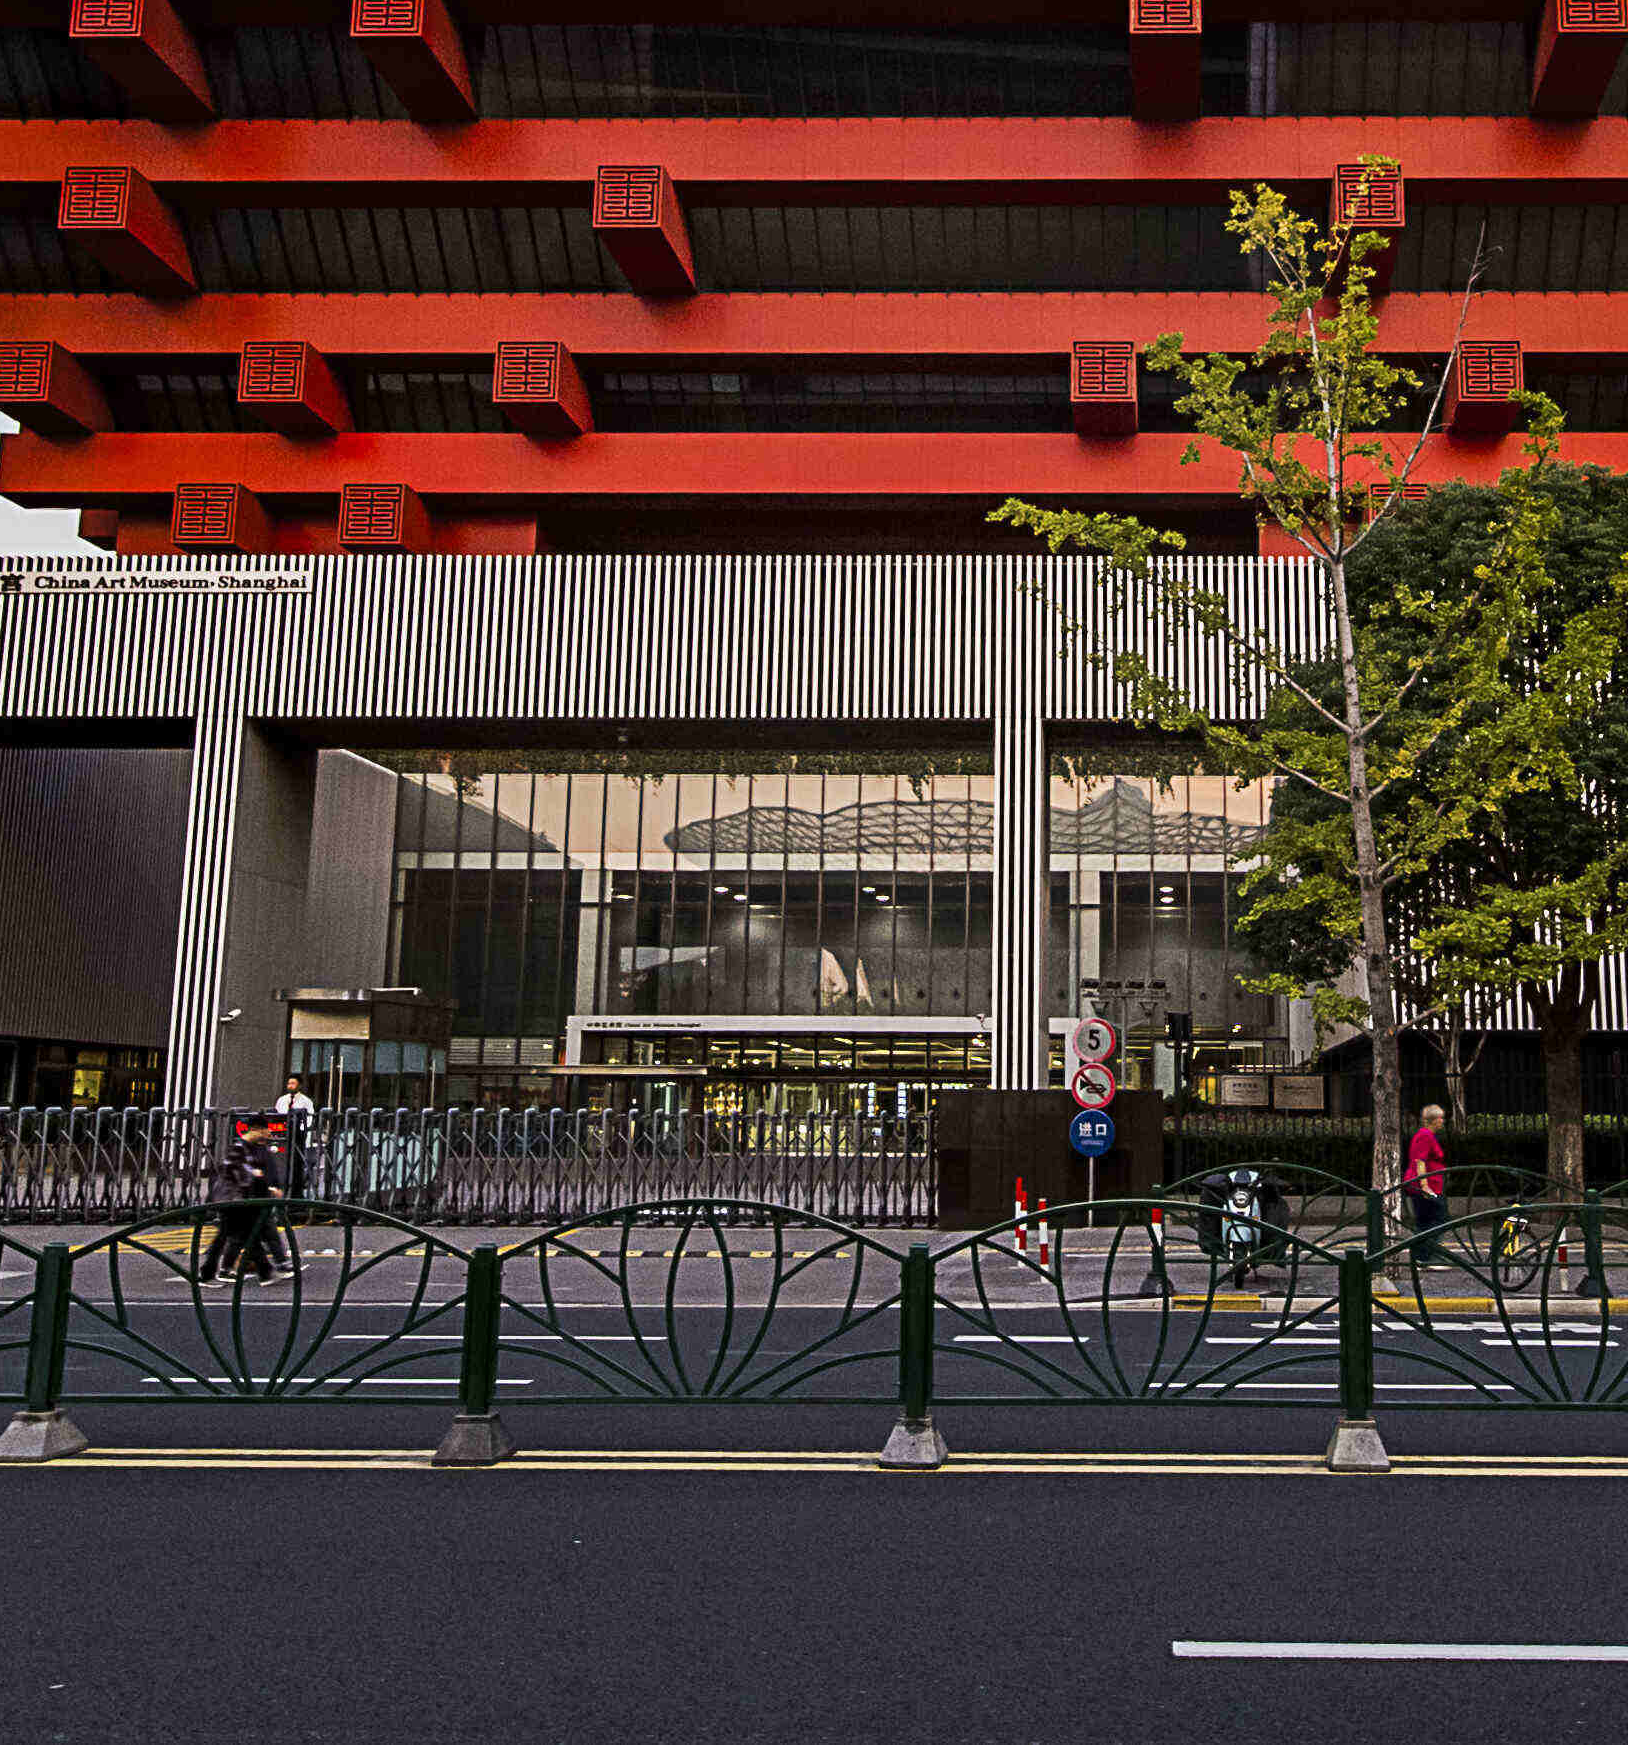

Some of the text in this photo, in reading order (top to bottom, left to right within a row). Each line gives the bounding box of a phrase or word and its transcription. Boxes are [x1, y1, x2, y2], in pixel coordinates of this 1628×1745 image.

[34, 575, 90, 590] China
[94, 576, 126, 589] Art
[217, 575, 307, 591] Shanghai
[1088, 1029, 1100, 1050] 5
[1078, 1121, 1107, 1137] 进口
